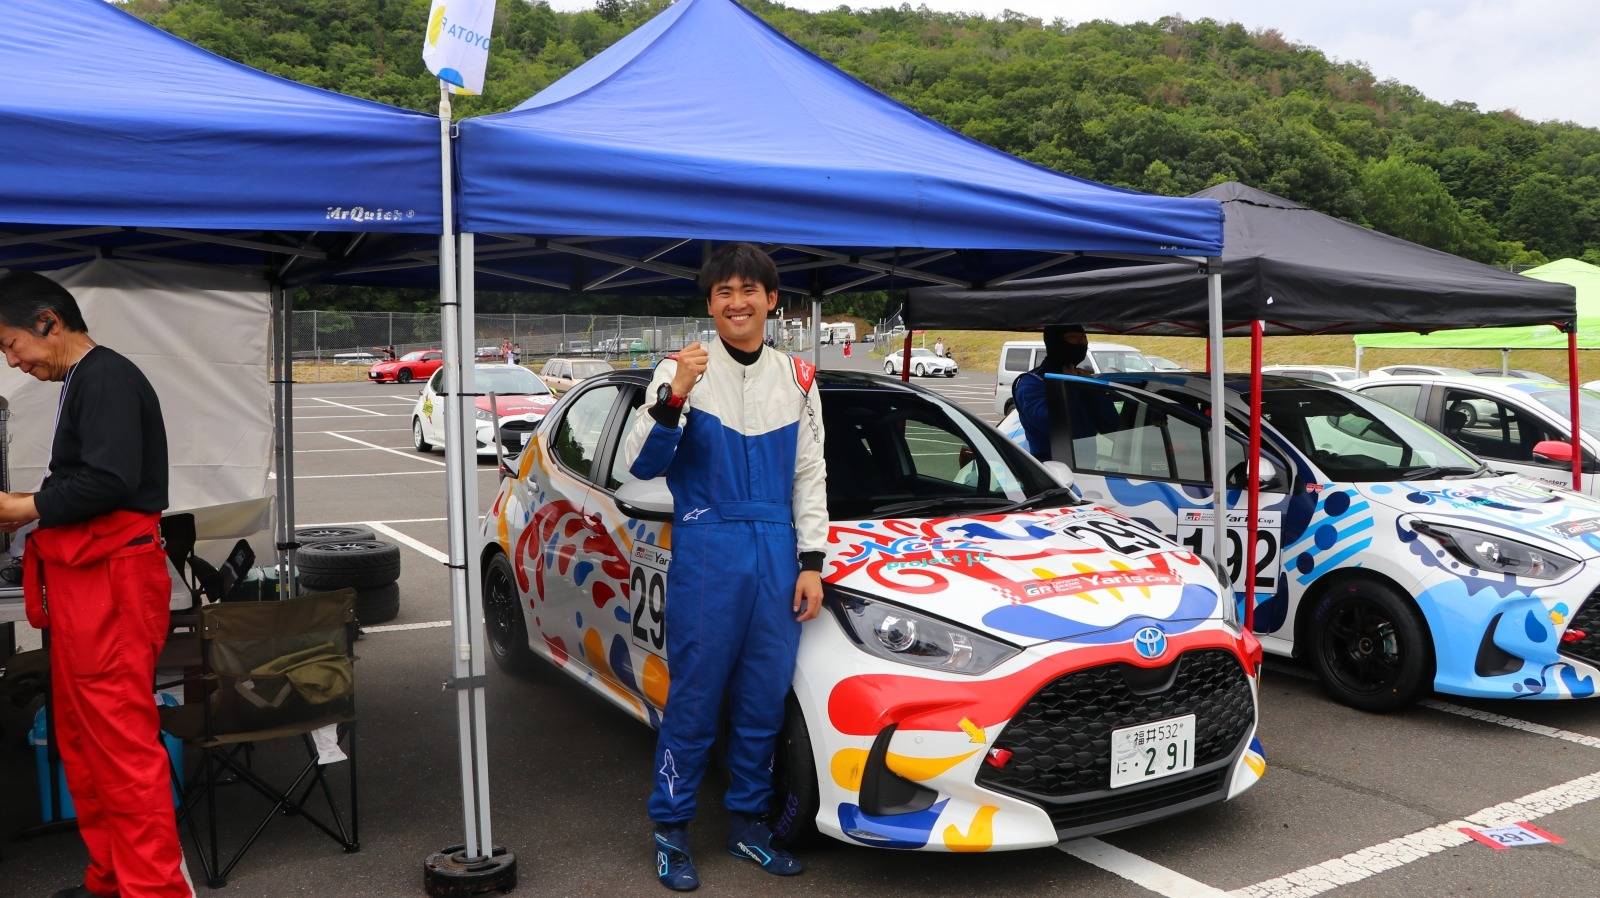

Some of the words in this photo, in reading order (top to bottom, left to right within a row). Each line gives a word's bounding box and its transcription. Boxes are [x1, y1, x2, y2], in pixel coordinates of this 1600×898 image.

[846, 536, 992, 563] Netz
[655, 552, 672, 566] Yari
[1080, 574, 1143, 586] Yaris
[1145, 575, 1170, 583] Cup
[1026, 585, 1051, 597] GR
[631, 566, 665, 650] 29
